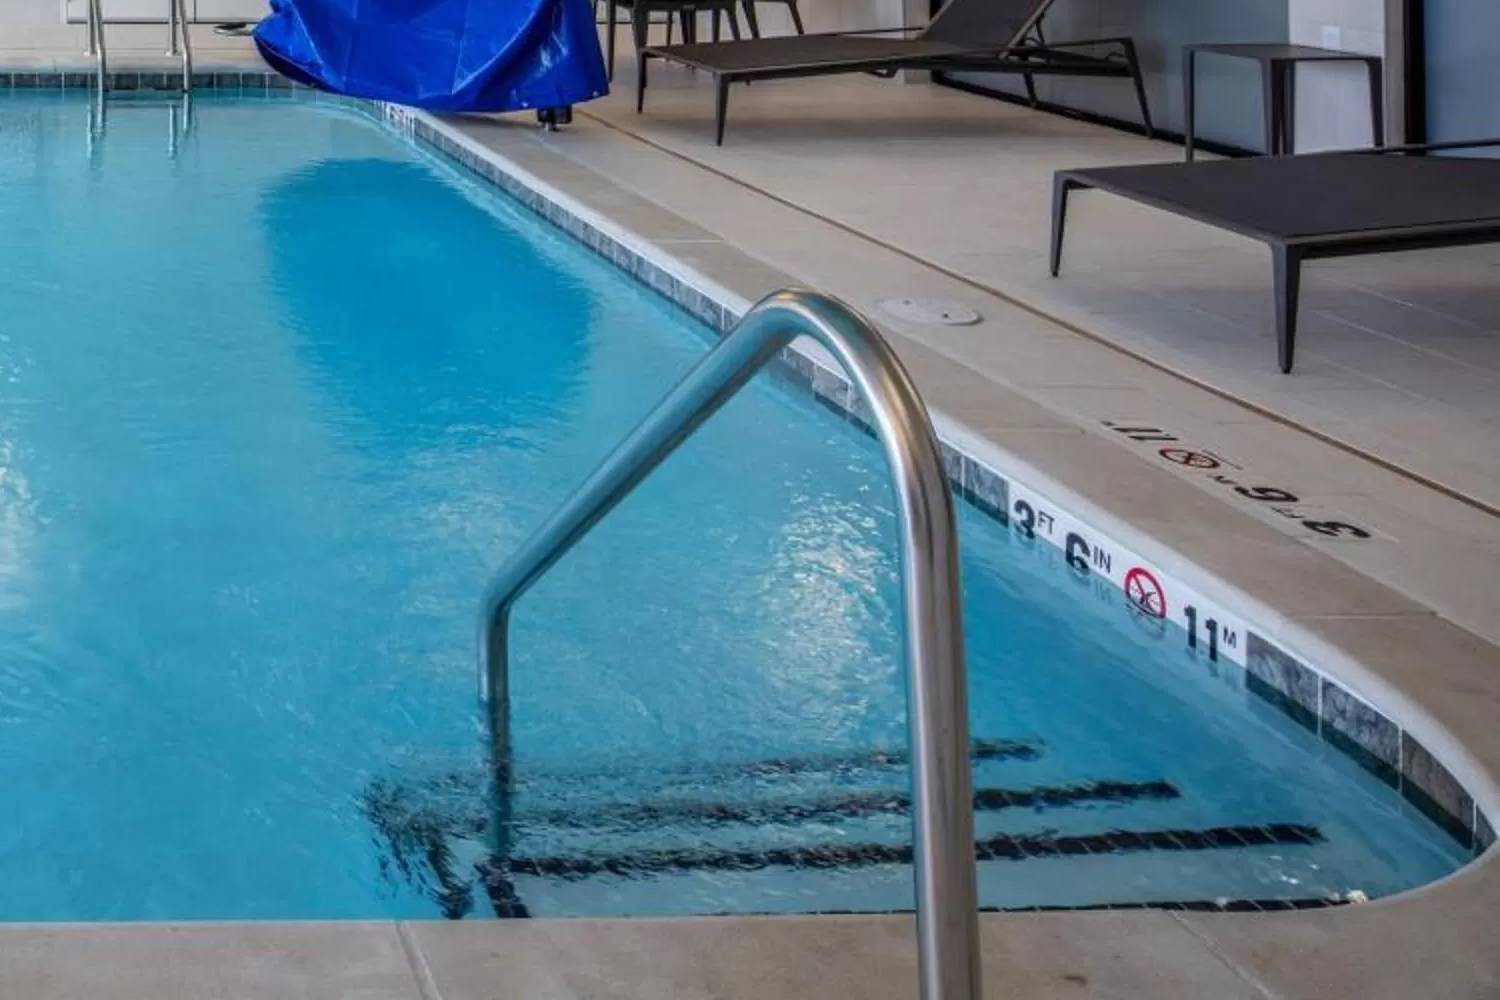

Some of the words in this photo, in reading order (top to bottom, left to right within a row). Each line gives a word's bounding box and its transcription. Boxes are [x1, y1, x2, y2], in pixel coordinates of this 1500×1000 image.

[1014, 499, 1036, 540] 3
[1037, 511, 1055, 534] FT
[1065, 532, 1091, 571] 6
[1093, 546, 1111, 573] IN
[1184, 604, 1218, 662] 11
[1223, 626, 1237, 648] M
